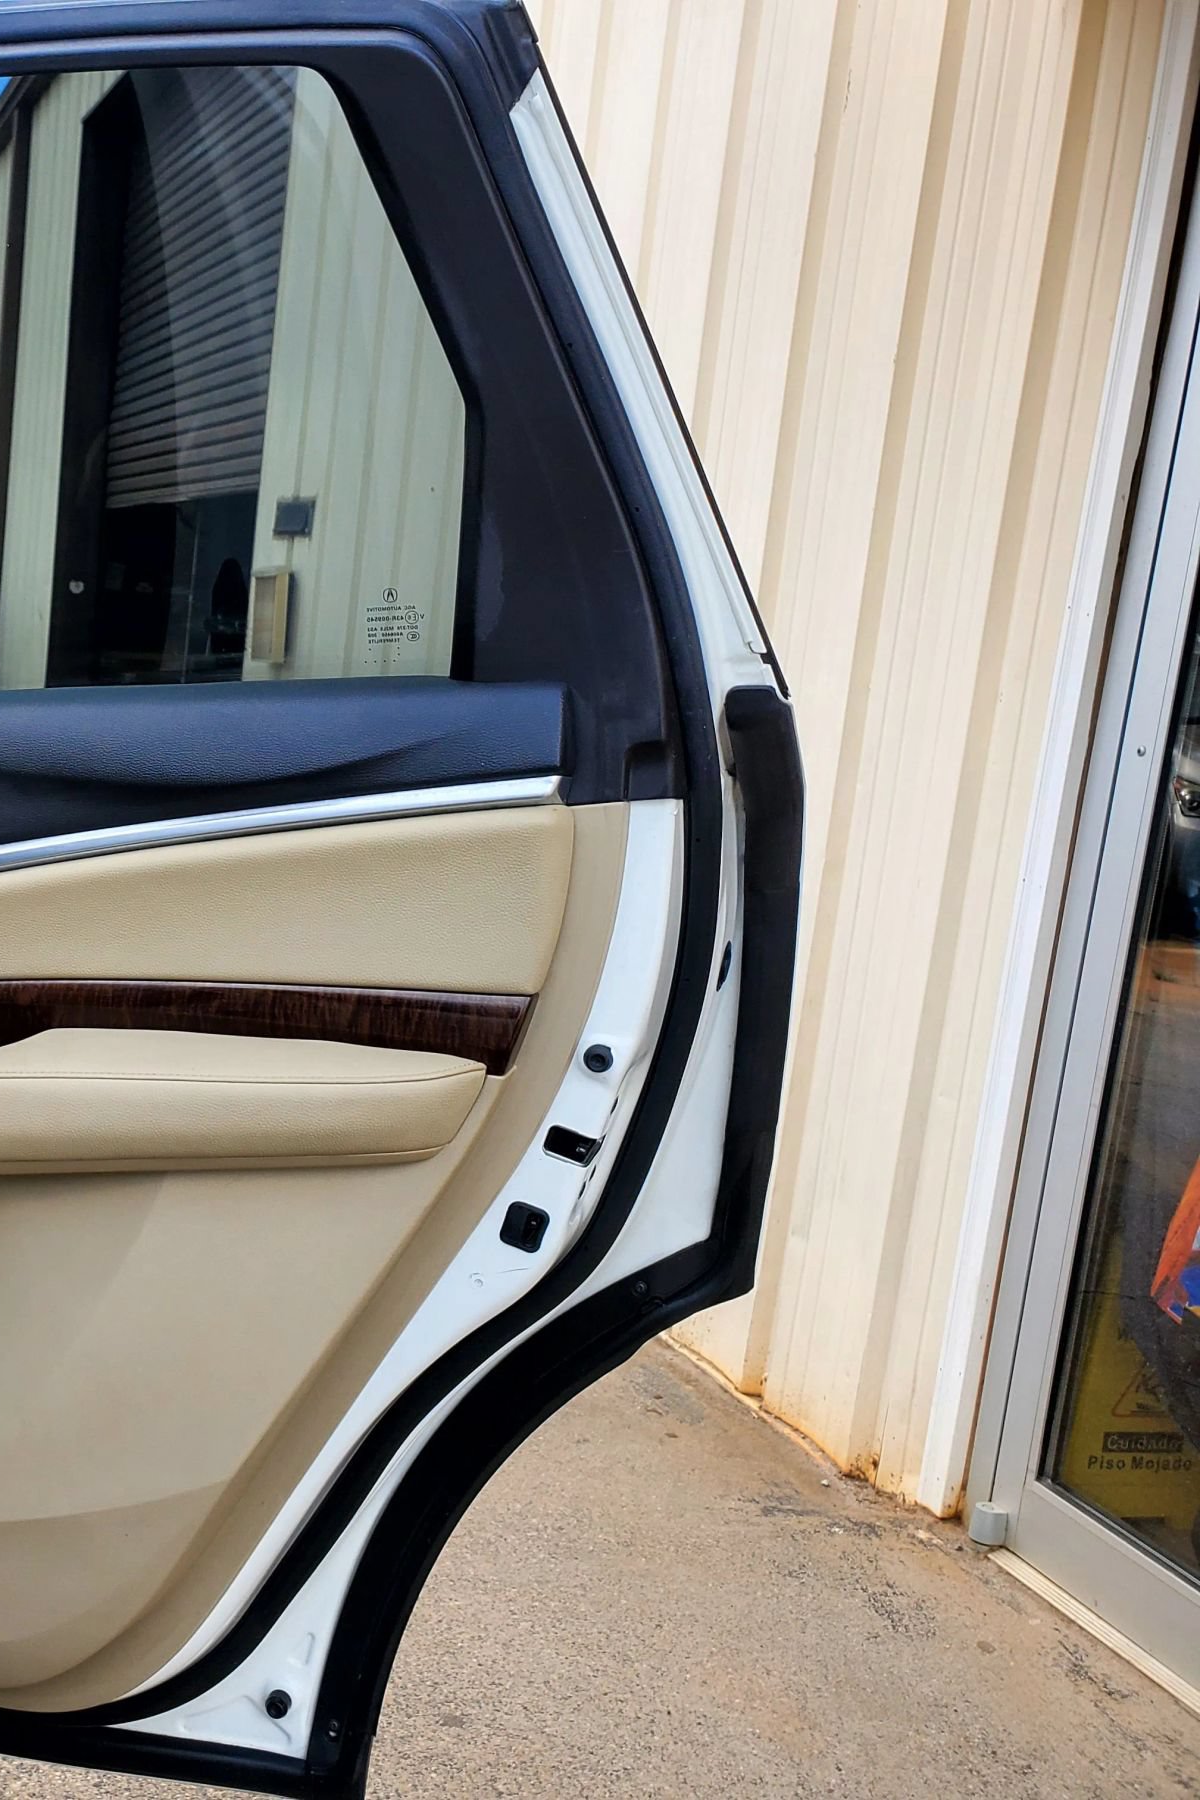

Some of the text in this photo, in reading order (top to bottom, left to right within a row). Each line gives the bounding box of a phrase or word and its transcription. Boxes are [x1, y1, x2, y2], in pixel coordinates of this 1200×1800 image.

[1107, 1434, 1184, 1449] Cuidado
[1087, 1455, 1192, 1473] Piso Mojado
